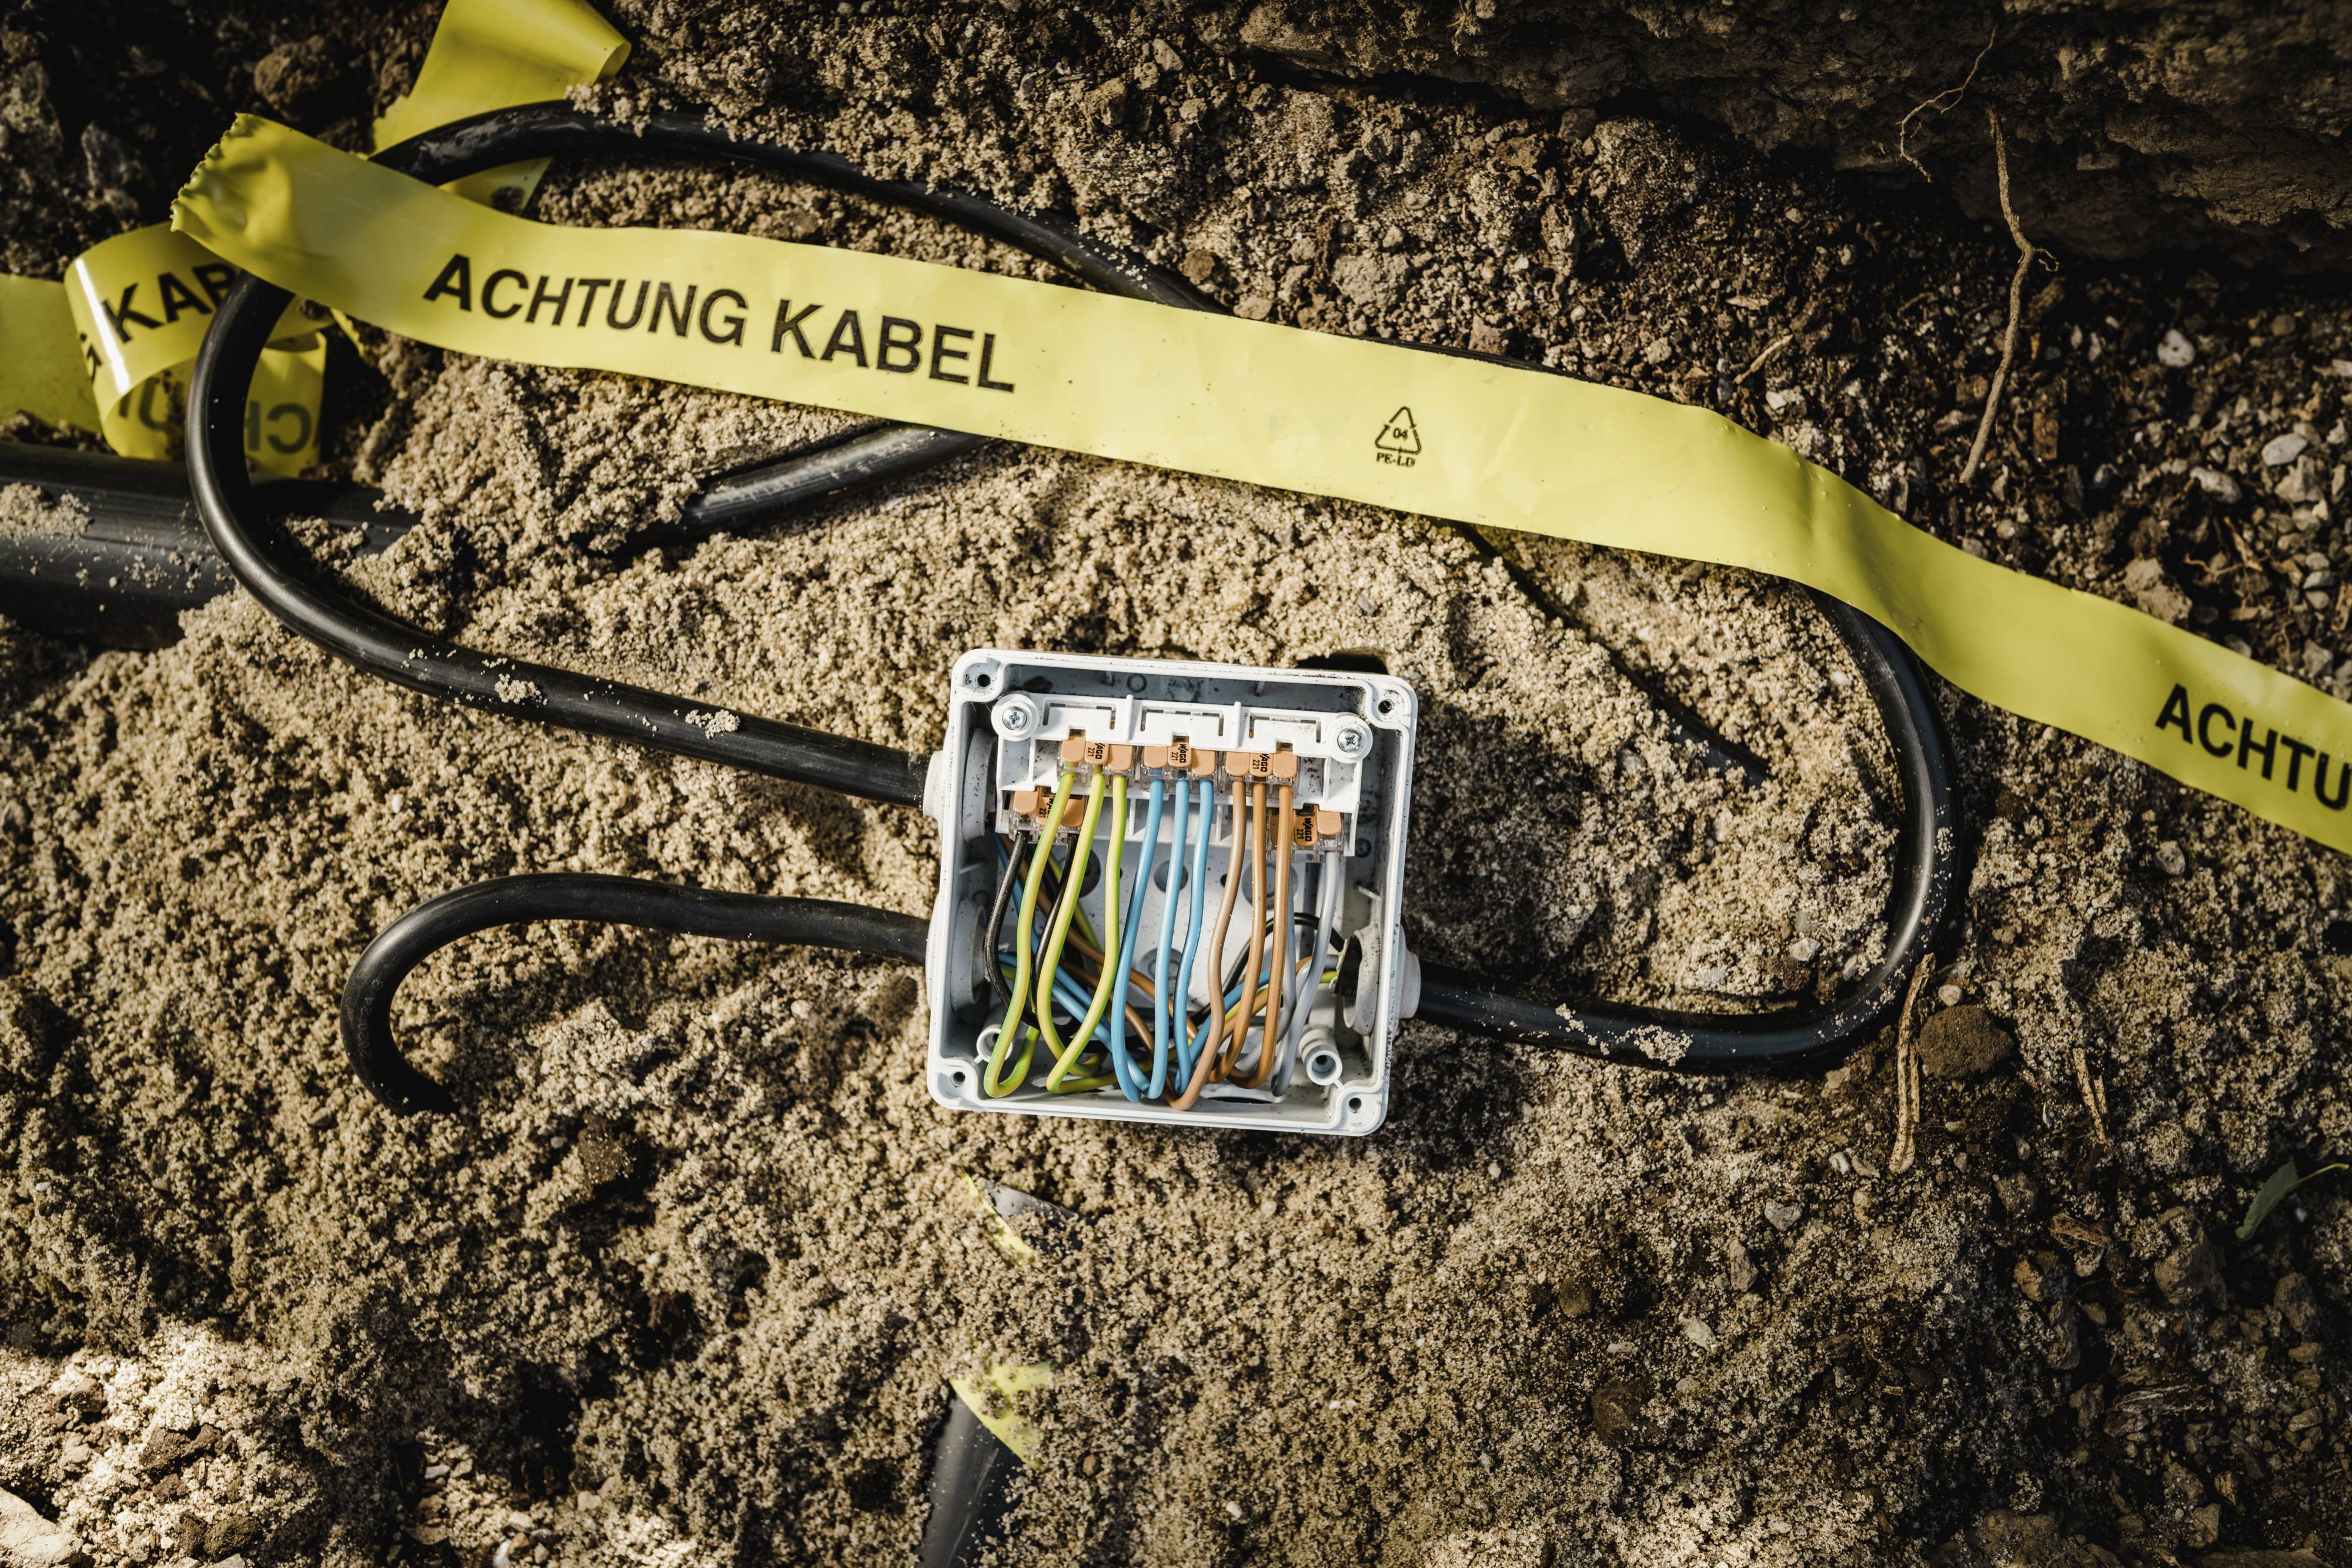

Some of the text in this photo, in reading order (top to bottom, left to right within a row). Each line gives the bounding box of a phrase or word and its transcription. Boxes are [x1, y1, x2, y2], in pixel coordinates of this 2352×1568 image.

[423, 253, 1015, 393] ACHTUNG KABEL
[1393, 428, 1408, 441] 04
[1087, 747, 1095, 757] 221
[1178, 743, 1188, 763] WAGO
[2154, 683, 2352, 811] ACHTU
[1302, 817, 1314, 841] WAGO
